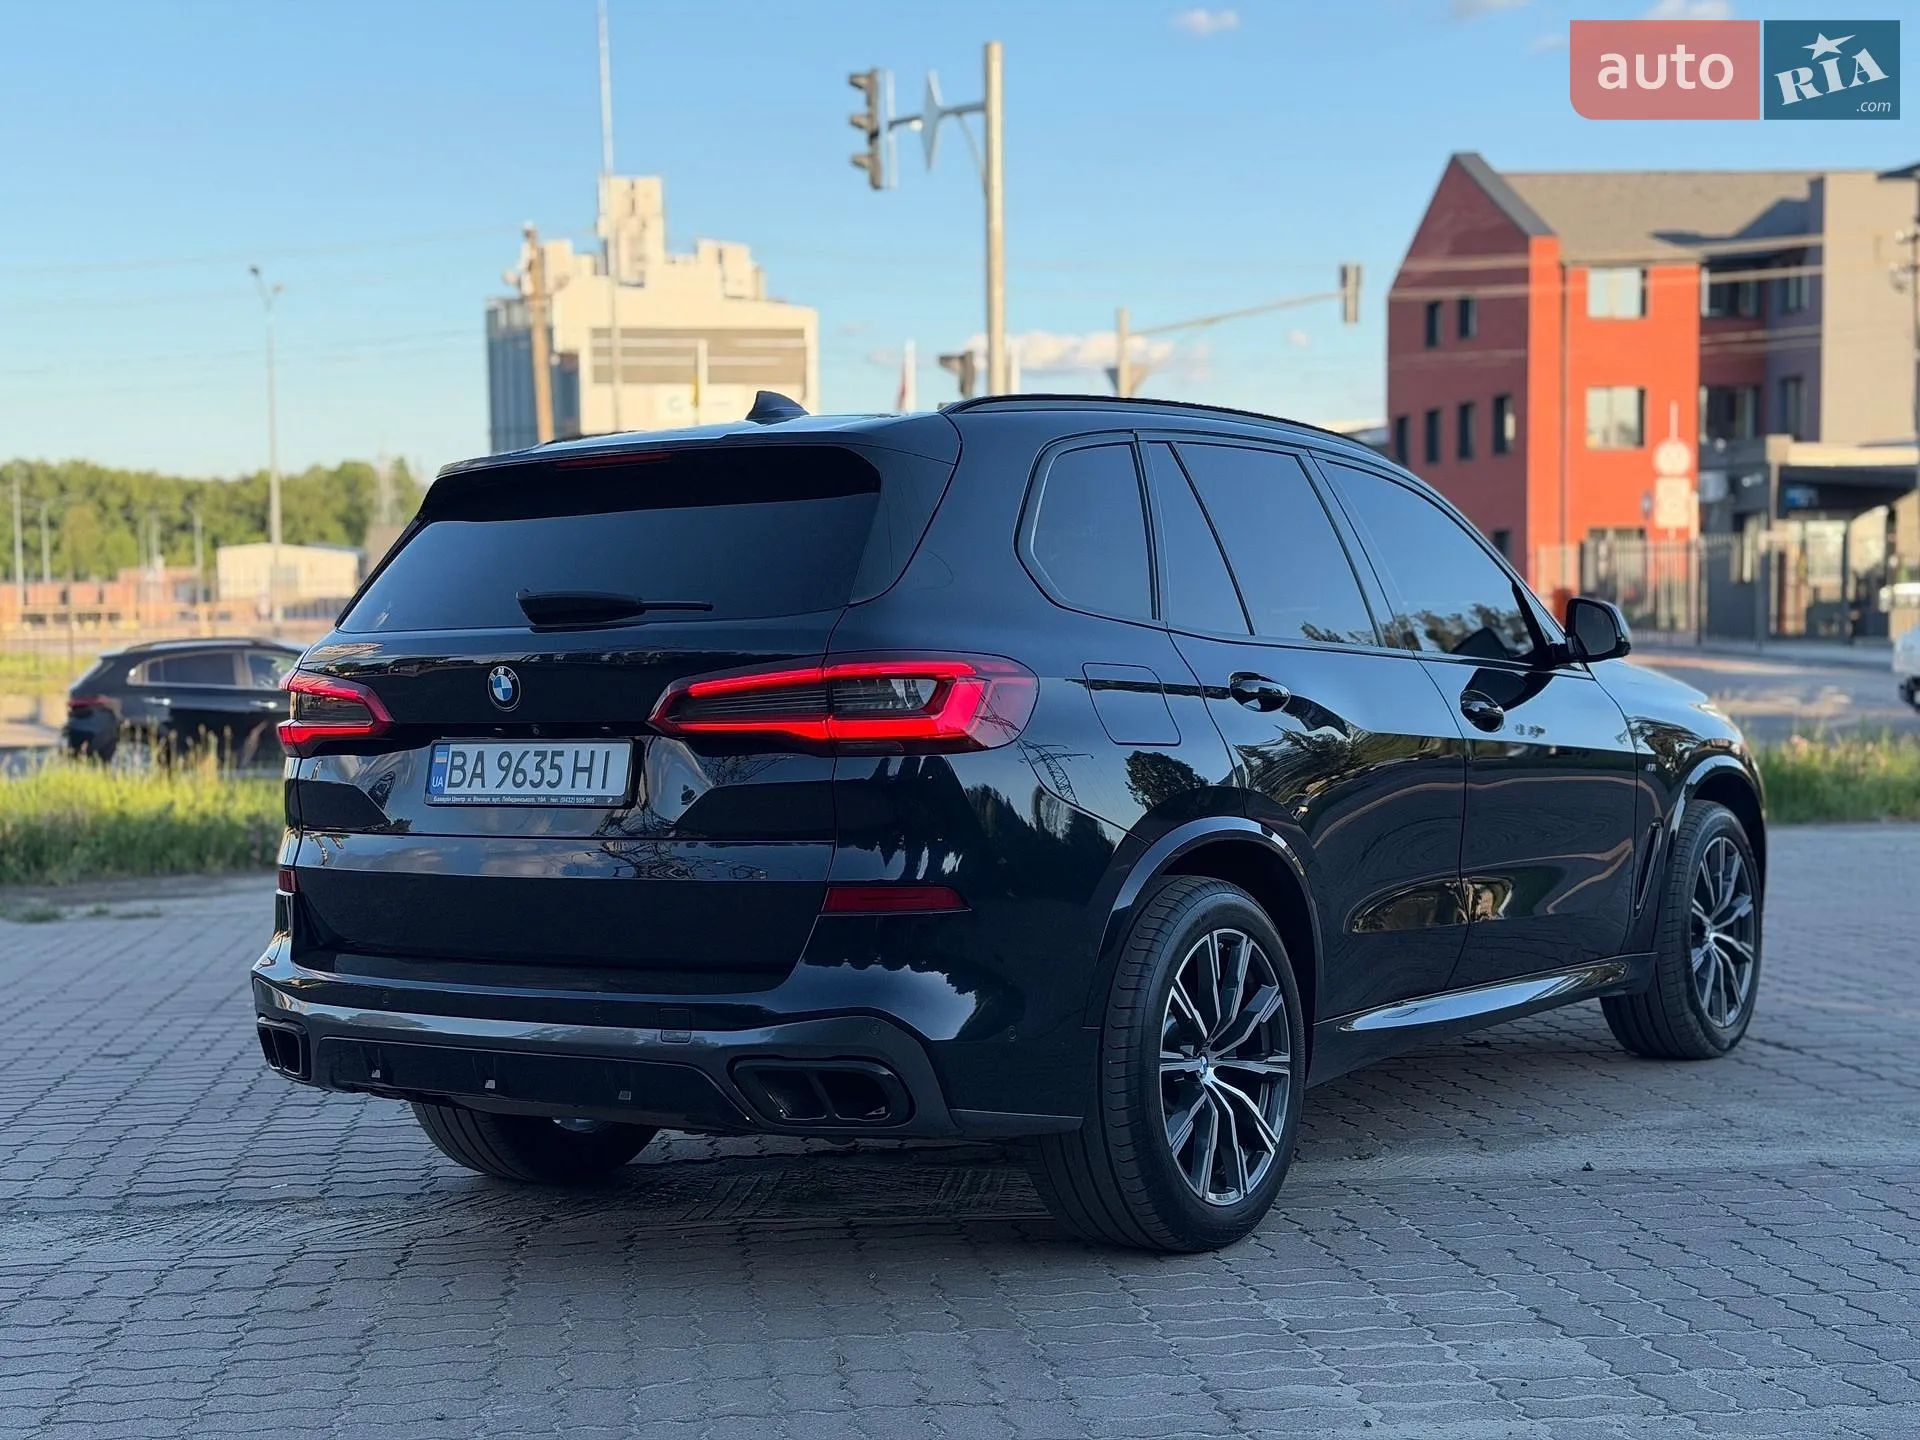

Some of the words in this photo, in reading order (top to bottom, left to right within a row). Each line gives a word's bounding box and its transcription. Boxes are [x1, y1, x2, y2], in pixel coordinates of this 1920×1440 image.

[432, 776, 444, 788] UA
[447, 750, 486, 788] BA
[495, 750, 565, 789] 9635
[570, 750, 612, 789] HI
